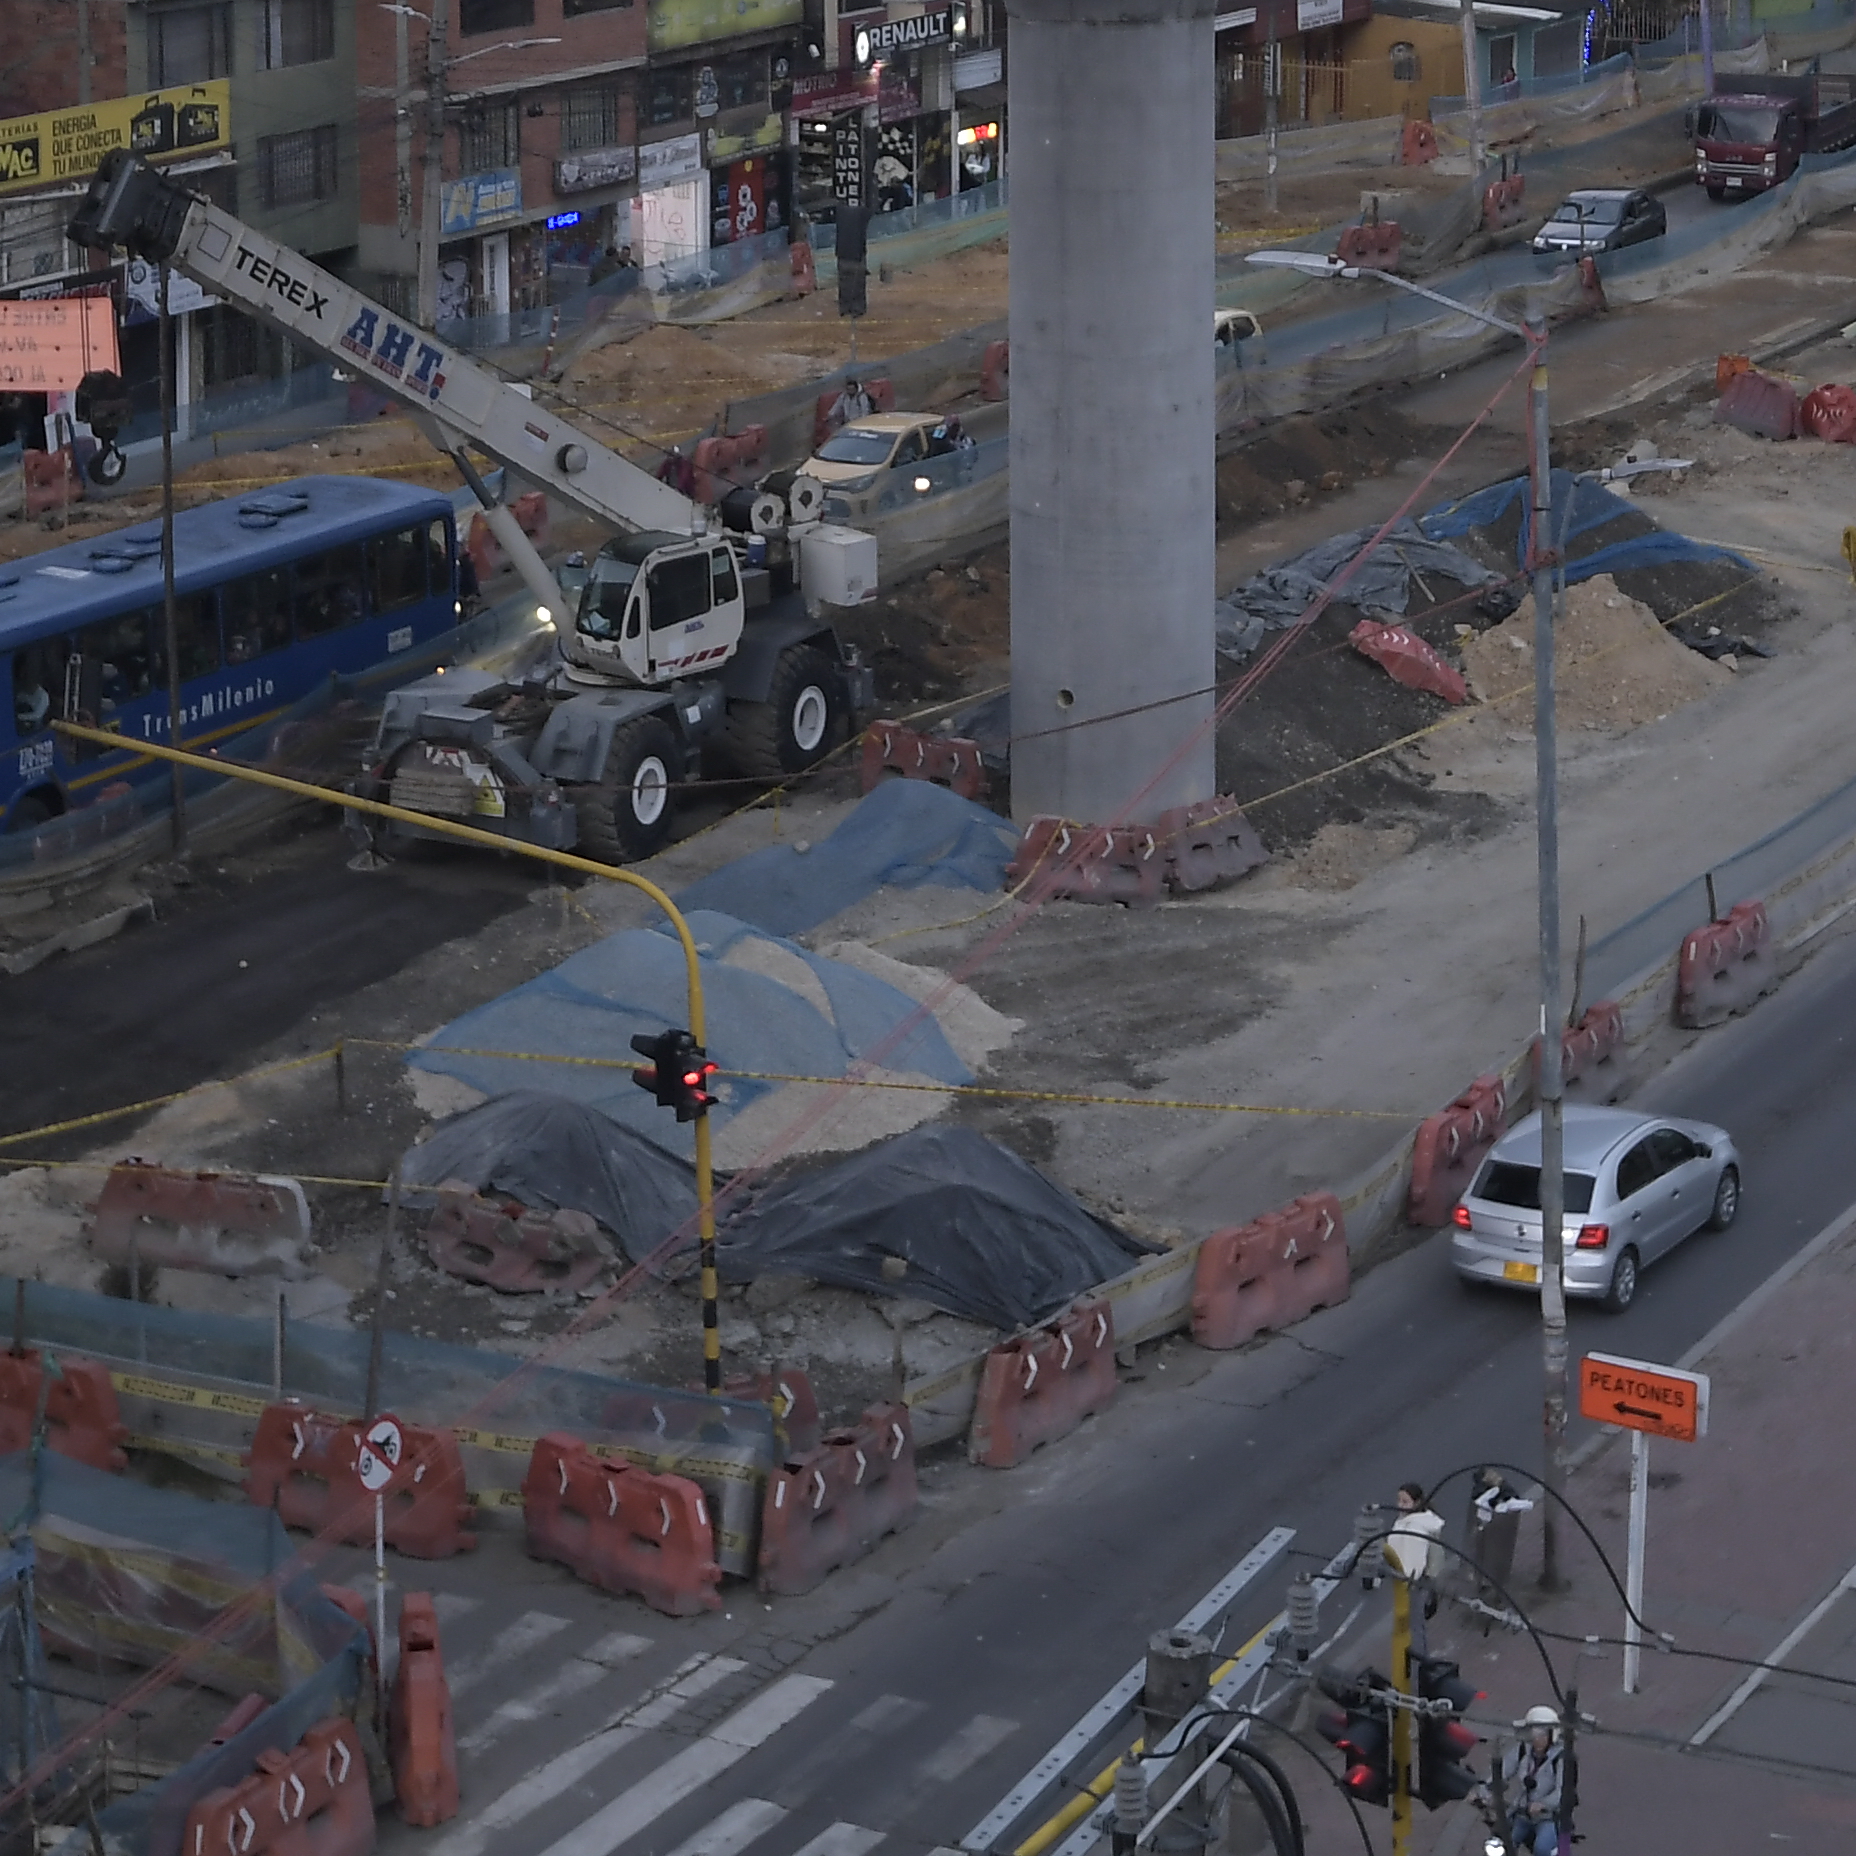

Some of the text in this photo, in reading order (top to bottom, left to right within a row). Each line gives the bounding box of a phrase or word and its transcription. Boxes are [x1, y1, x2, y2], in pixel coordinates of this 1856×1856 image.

[869, 12, 947, 48] RENAULT
[52, 110, 97, 137] ENERGÍA
[52, 128, 122, 156] QUE CONECTA
[52, 150, 106, 175] TU MUND
[835, 130, 848, 198] PINTU
[235, 246, 328, 320] TEREX
[1590, 1371, 1684, 1407] PEATONES
